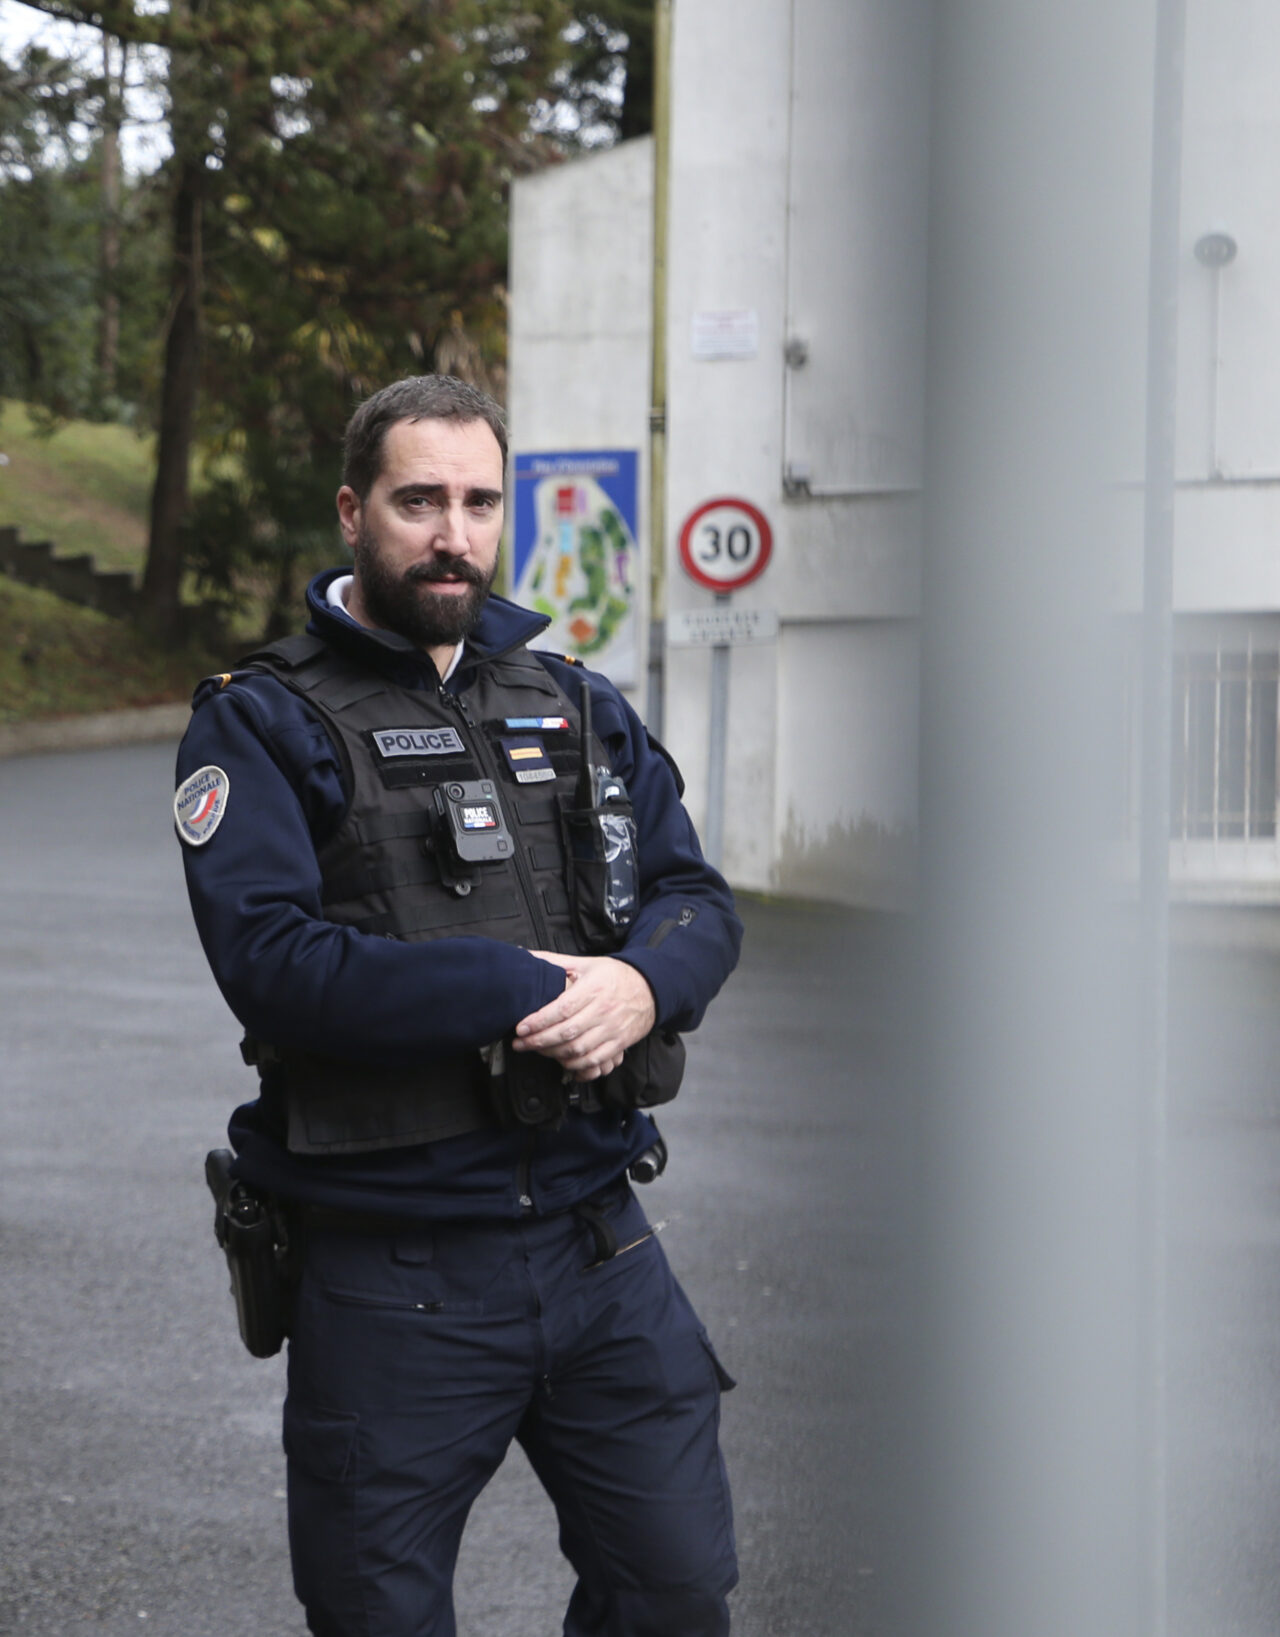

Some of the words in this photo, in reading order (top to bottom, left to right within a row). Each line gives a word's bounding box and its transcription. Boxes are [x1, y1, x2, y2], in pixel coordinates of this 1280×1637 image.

[701, 525, 752, 562] 30
[381, 733, 456, 751] POLICE
[177, 777, 221, 810] NATIONALE
[184, 773, 210, 795] POLICE
[464, 807, 489, 818] POLICE
